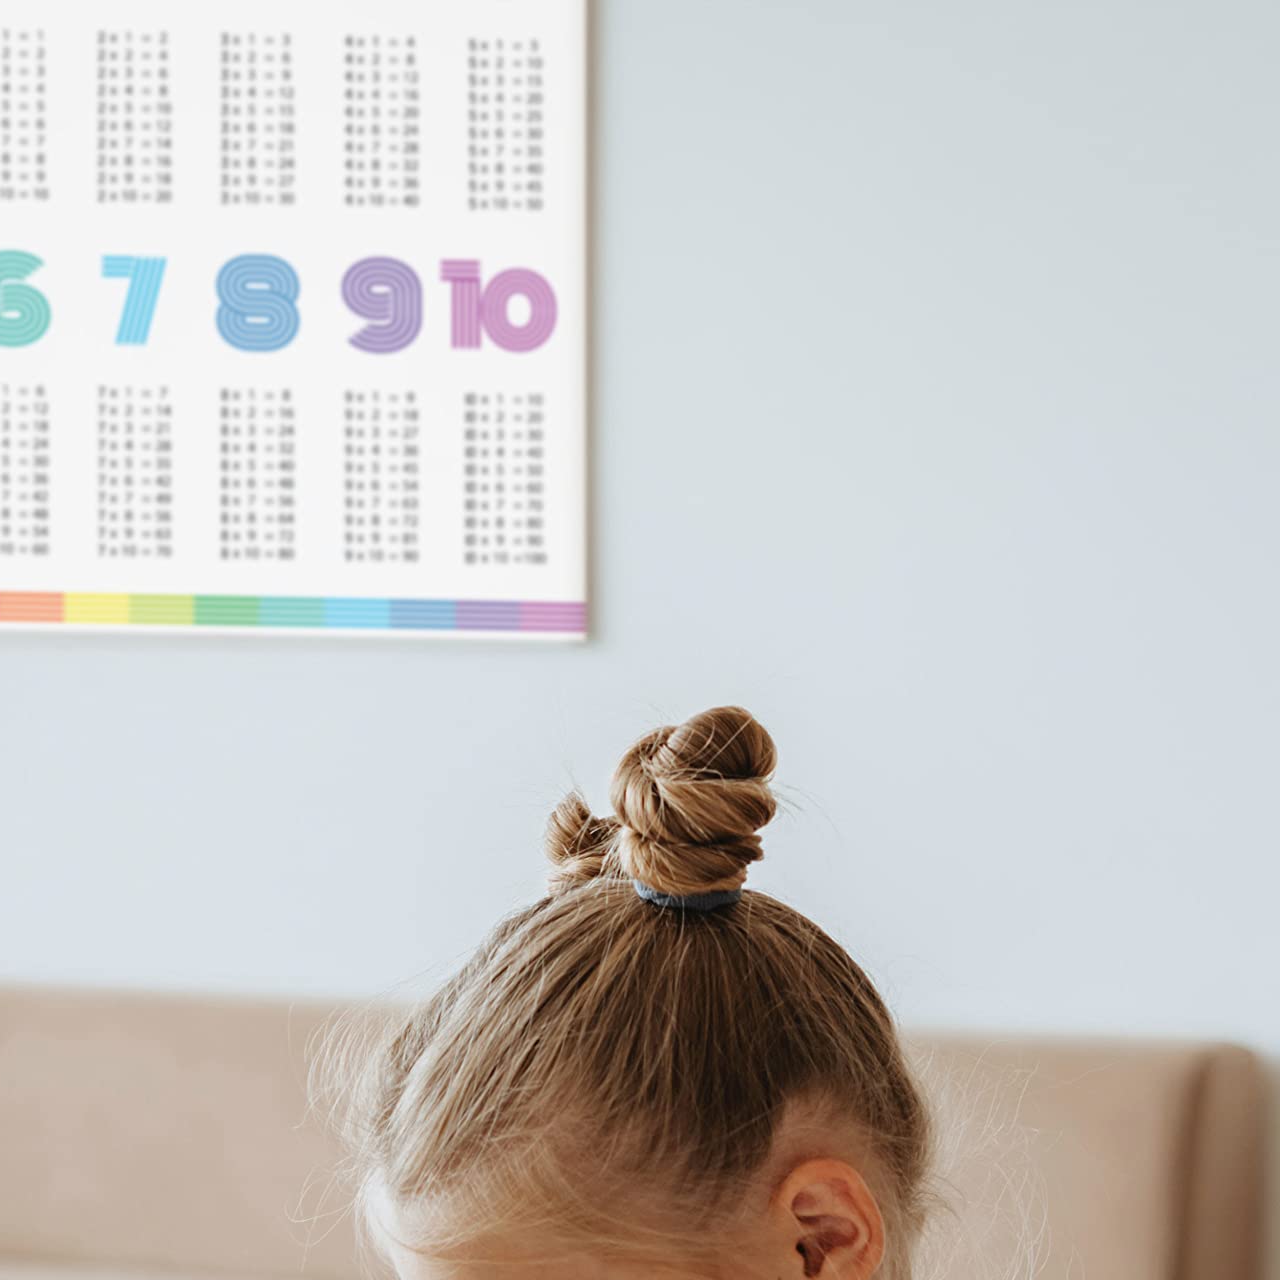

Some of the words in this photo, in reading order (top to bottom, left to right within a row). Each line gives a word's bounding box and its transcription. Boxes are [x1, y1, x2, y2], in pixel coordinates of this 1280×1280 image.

[101, 255, 167, 345] 7
[215, 254, 301, 352] 8
[342, 258, 421, 352] 9
[442, 260, 556, 352] 10
